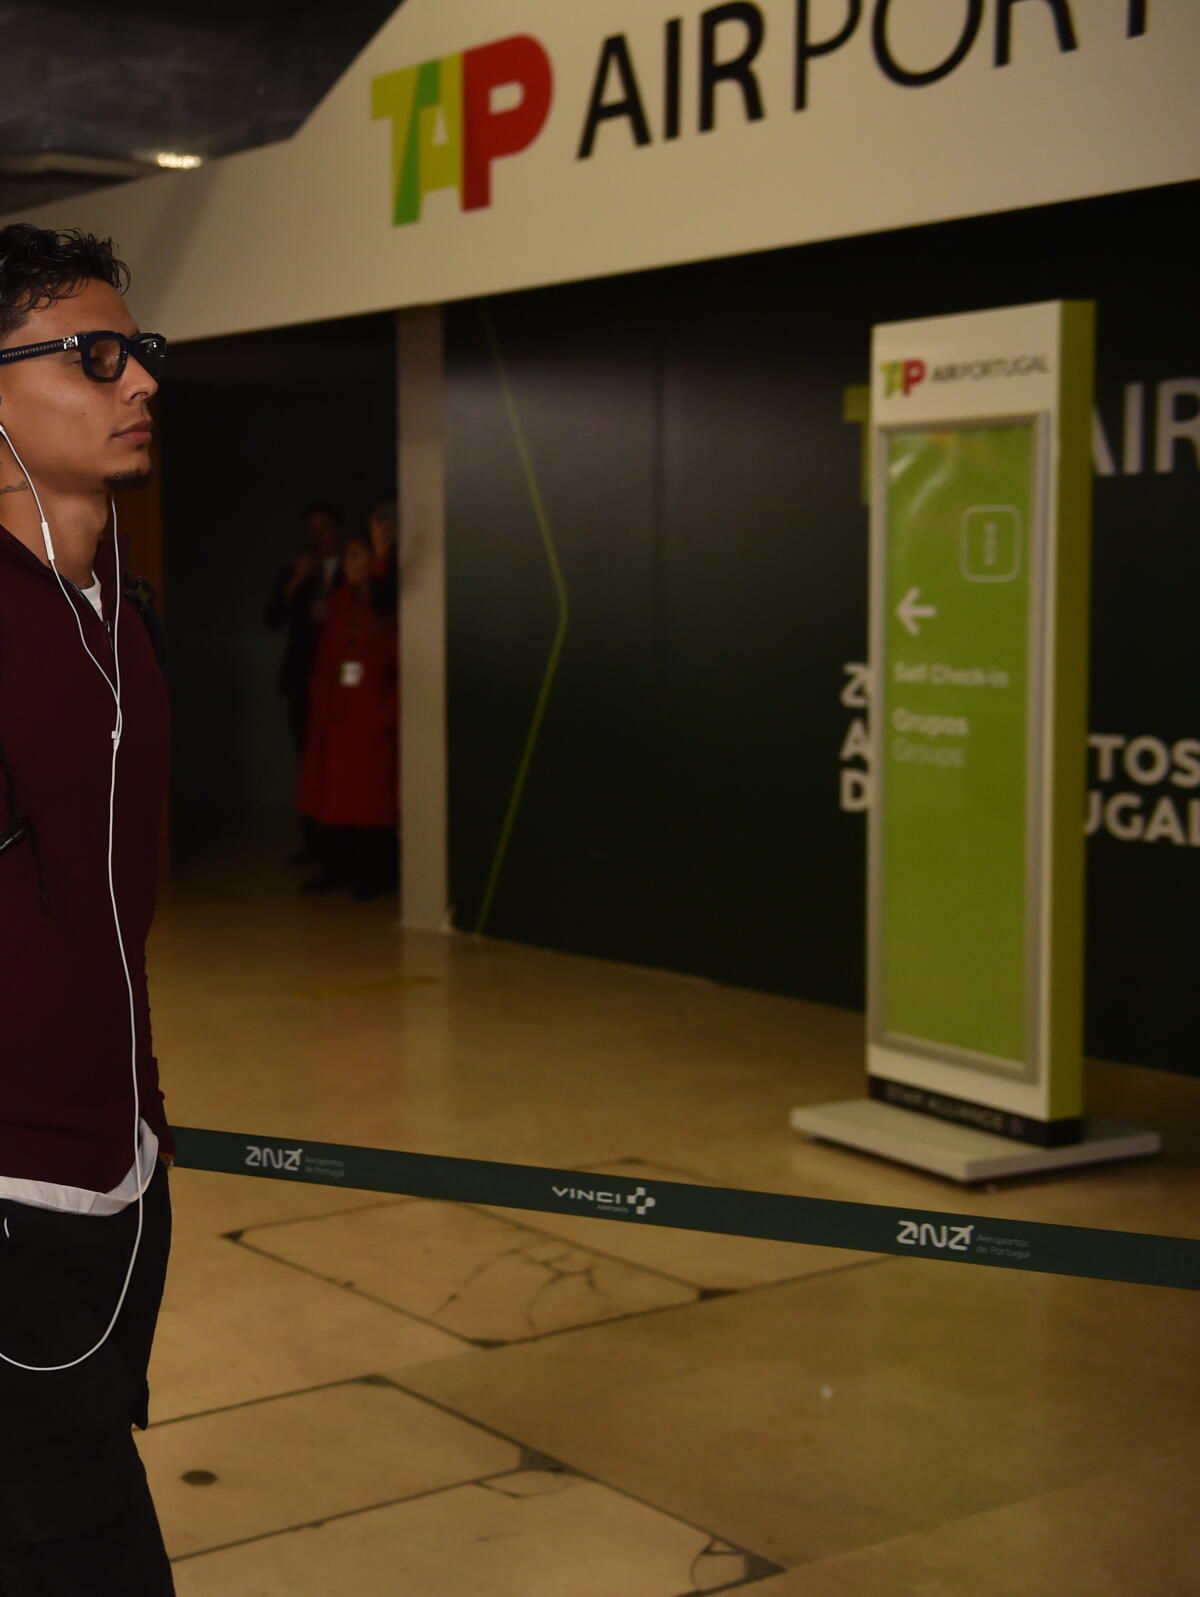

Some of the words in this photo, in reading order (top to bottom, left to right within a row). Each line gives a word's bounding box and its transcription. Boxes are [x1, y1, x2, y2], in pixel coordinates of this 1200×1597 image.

[371, 33, 555, 228] TAP
[880, 358, 927, 398] TAP
[552, 1186, 621, 1205] VINCI
